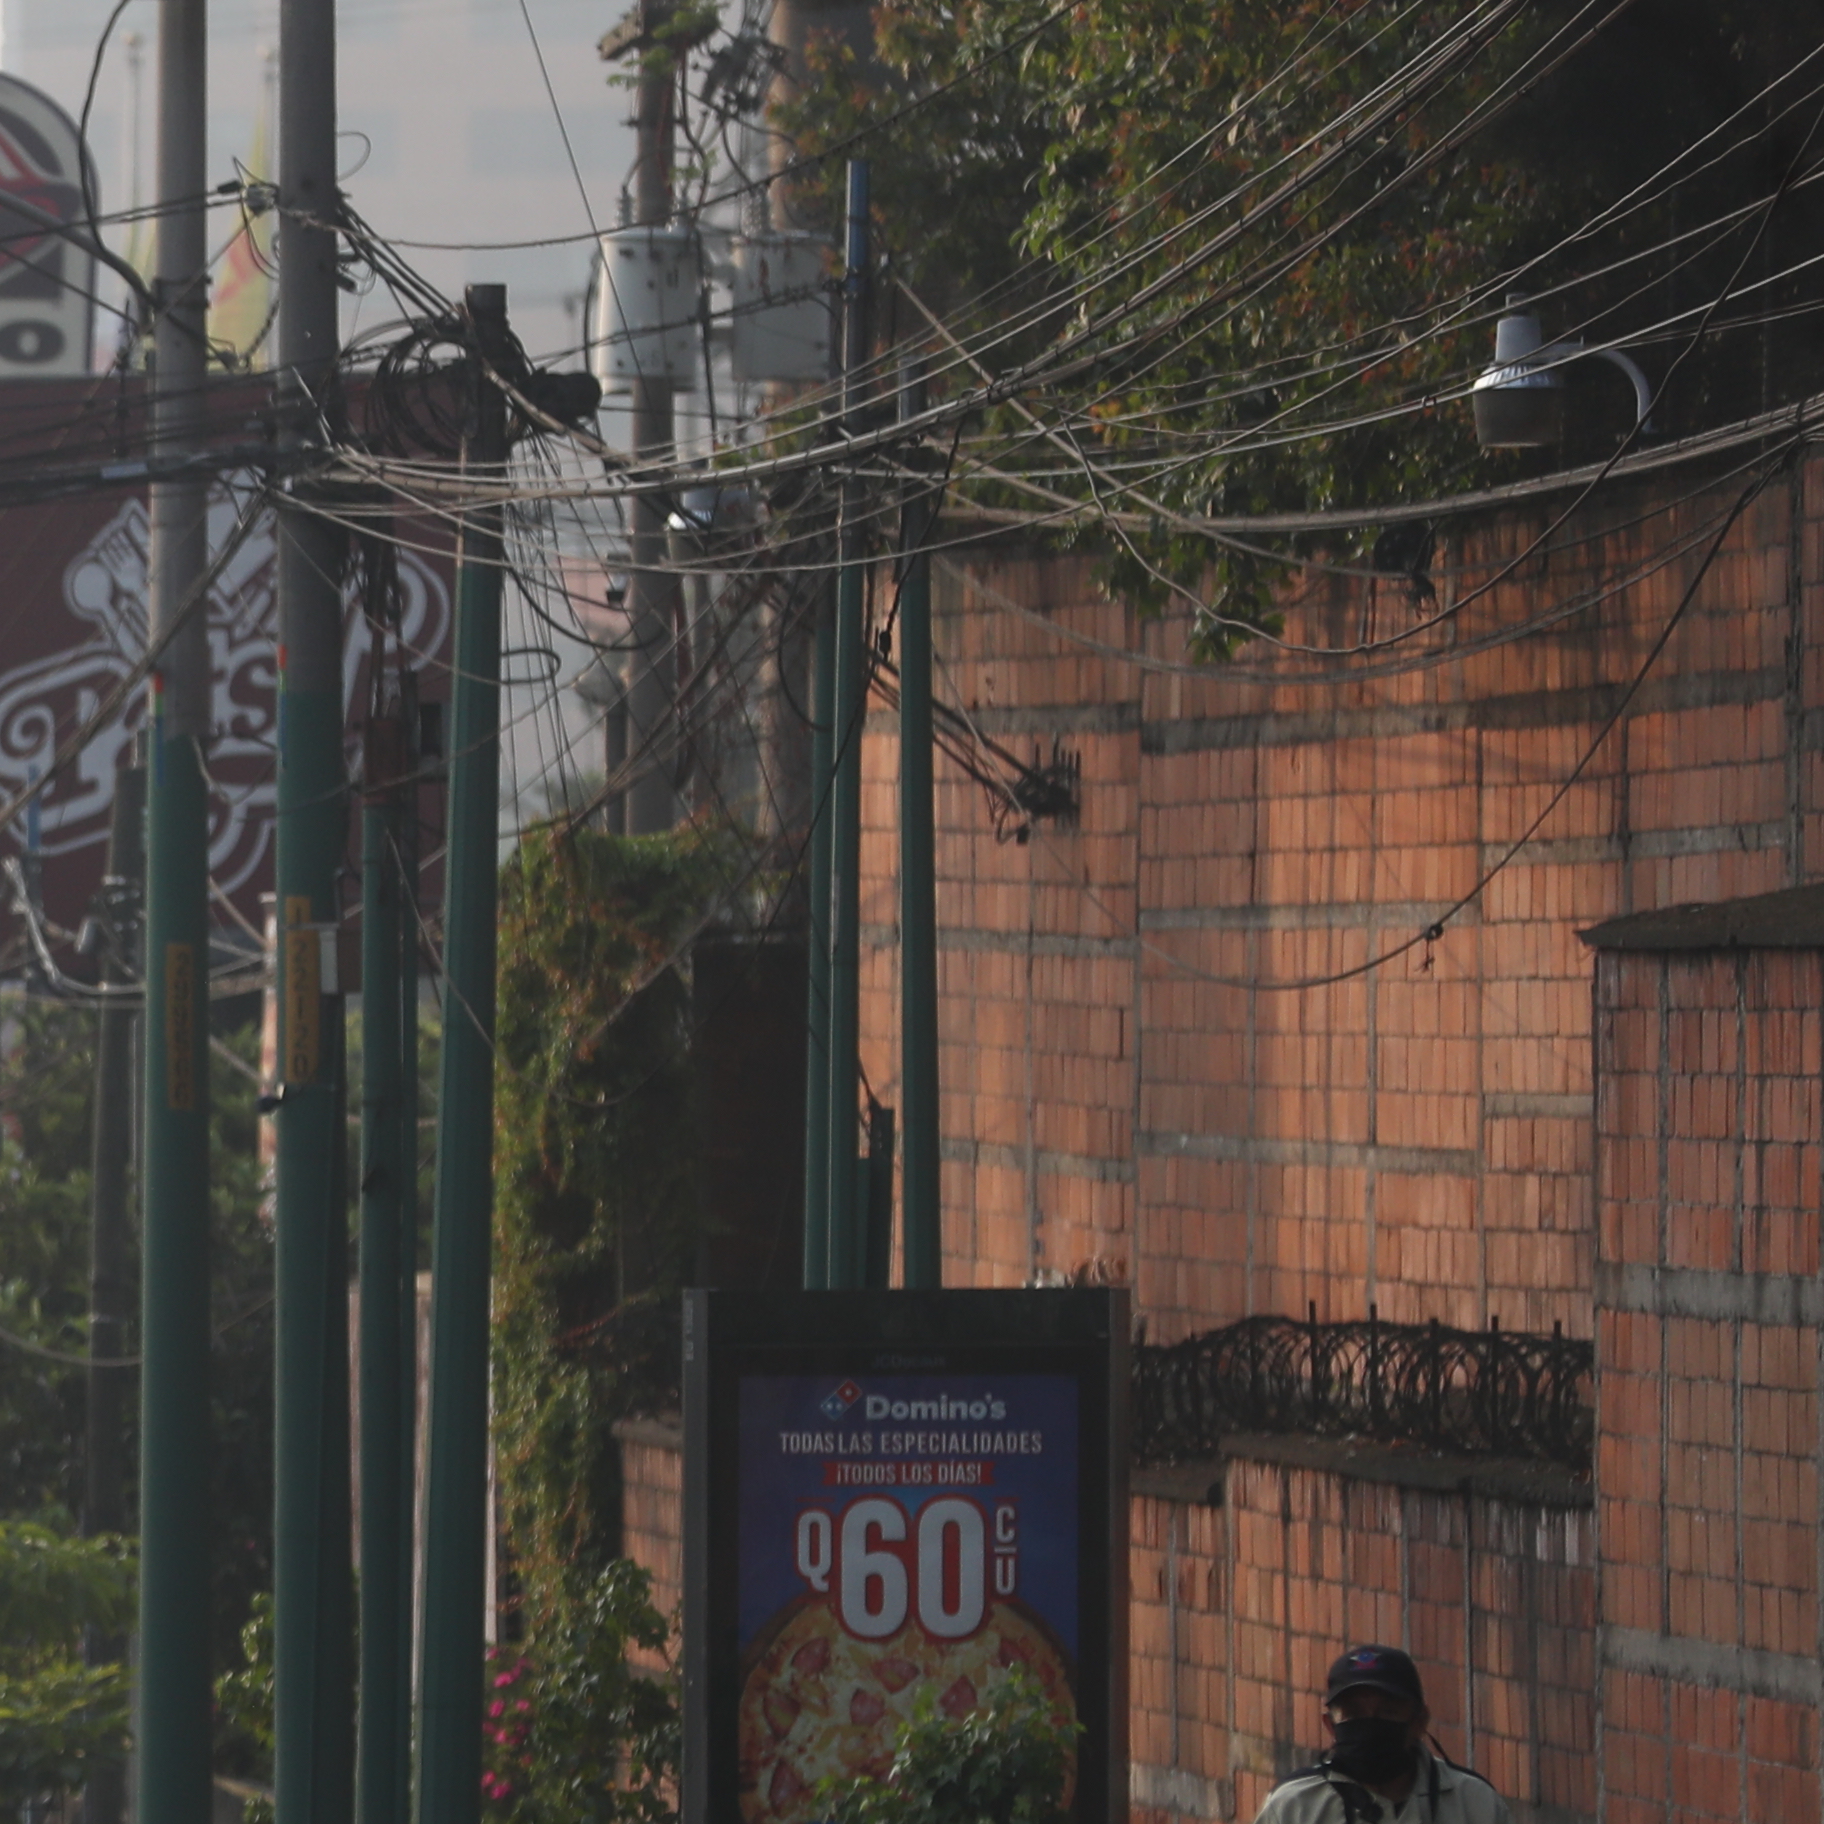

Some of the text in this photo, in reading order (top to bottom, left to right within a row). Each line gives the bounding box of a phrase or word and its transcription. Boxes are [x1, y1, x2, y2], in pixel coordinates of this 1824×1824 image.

[865, 1393, 1008, 1421] Domino's
[779, 1432, 1043, 1454] TODAS LAS ESPECIALIDADES
[836, 1458, 982, 1485] ¡TODOS LOS DÍAS!
